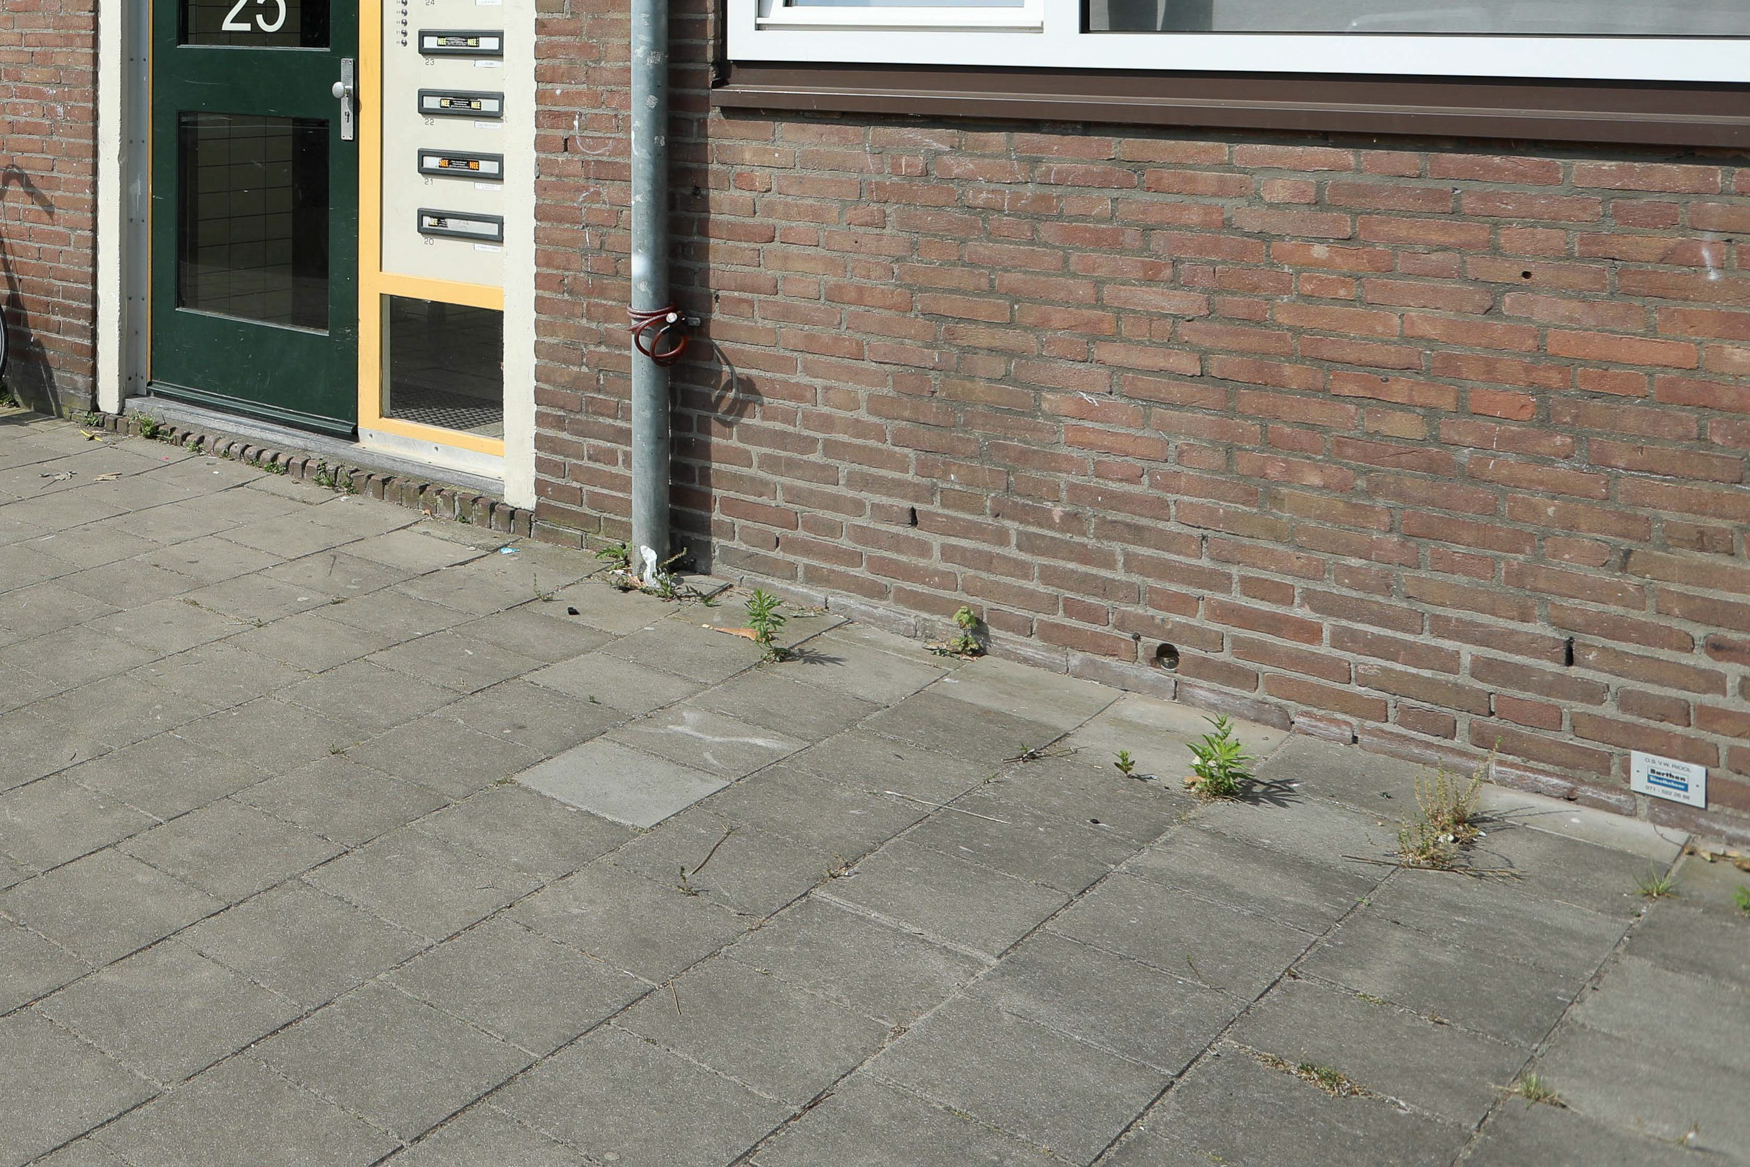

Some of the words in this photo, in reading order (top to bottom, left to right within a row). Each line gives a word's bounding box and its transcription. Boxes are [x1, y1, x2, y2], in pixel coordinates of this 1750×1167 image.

[438, 37, 447, 45] NEE
[467, 38, 477, 46] NEE
[424, 58, 435, 66] 23
[441, 99, 450, 107] NEE
[471, 101, 481, 109] NEE
[424, 118, 435, 126] 22
[439, 159, 449, 167] NEE
[469, 161, 479, 170] NEE
[423, 237, 434, 246] 20
